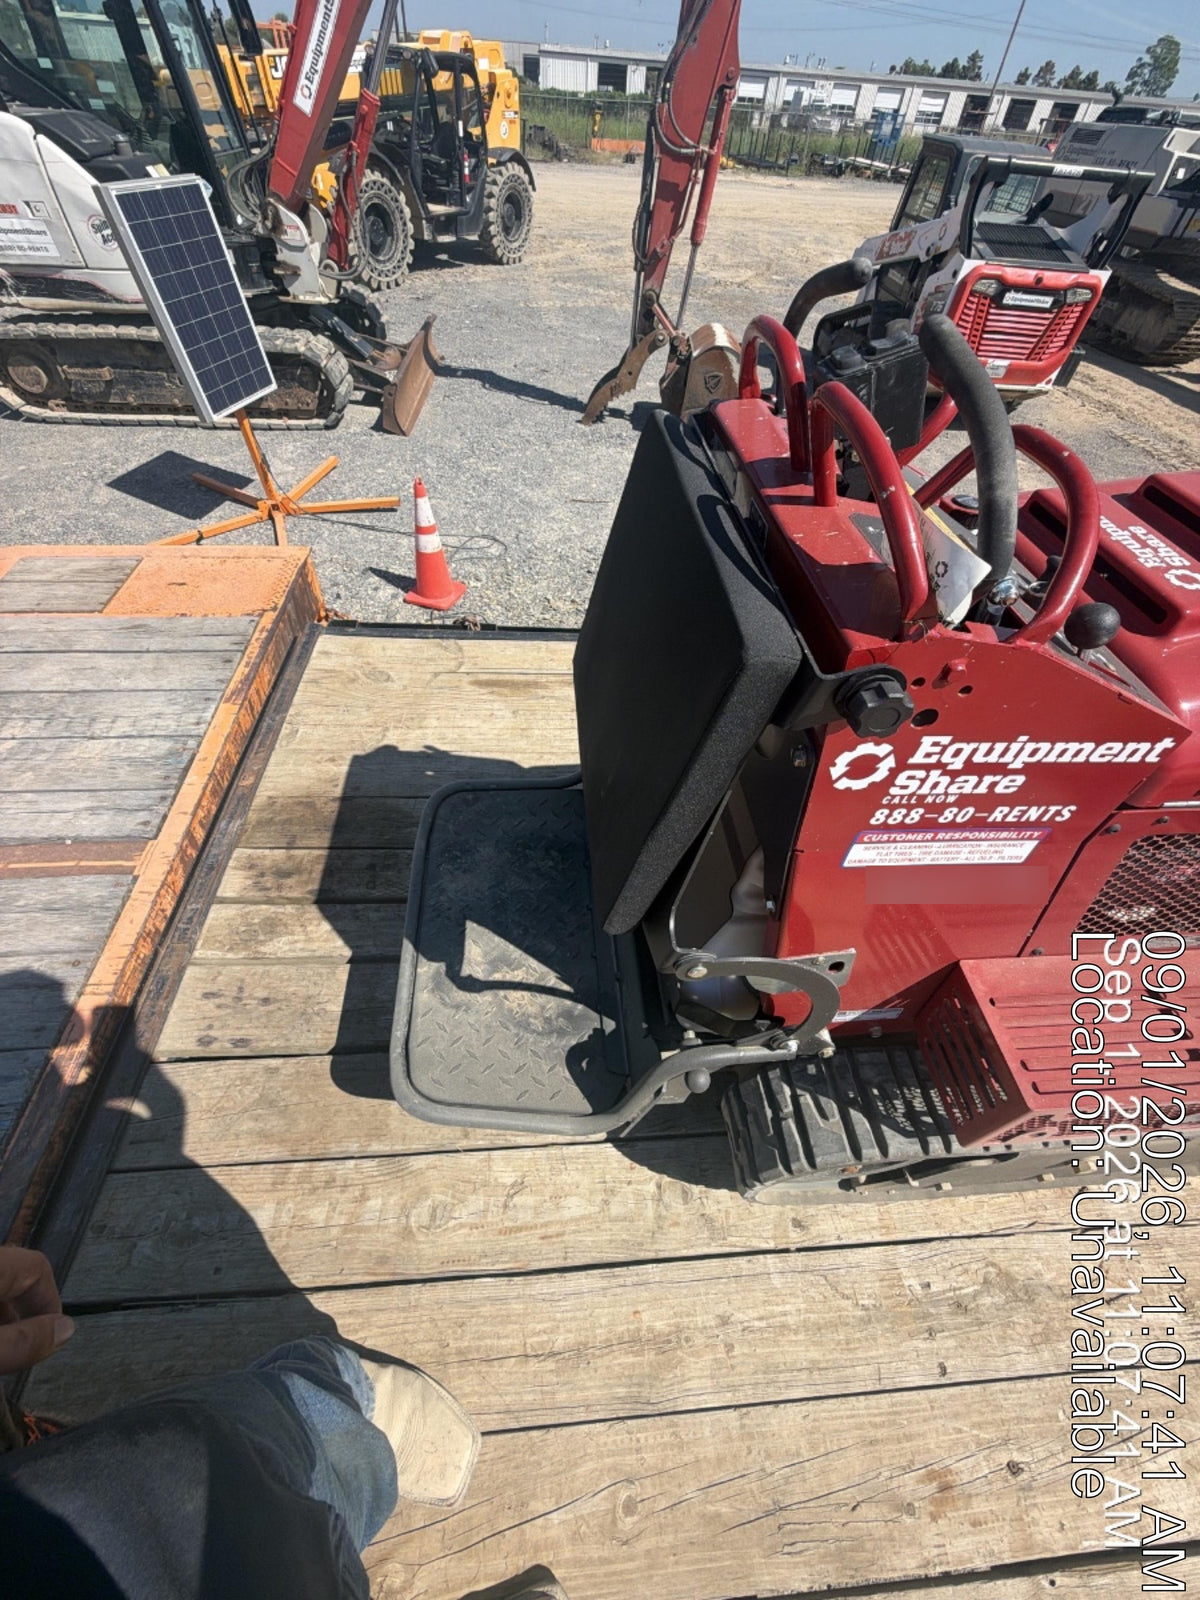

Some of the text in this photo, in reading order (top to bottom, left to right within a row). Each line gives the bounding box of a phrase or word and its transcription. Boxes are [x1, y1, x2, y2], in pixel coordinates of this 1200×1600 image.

[305, 0, 335, 86] EquipmentS
[1127, 526, 1191, 566] Share
[907, 735, 1176, 769] Equipment
[889, 769, 1027, 795] Share
[882, 794, 960, 804] CALL NOW
[869, 805, 1077, 825] 888-80-RENTS
[863, 830, 1042, 842] CUSTOMER RESPONSIBILITY
